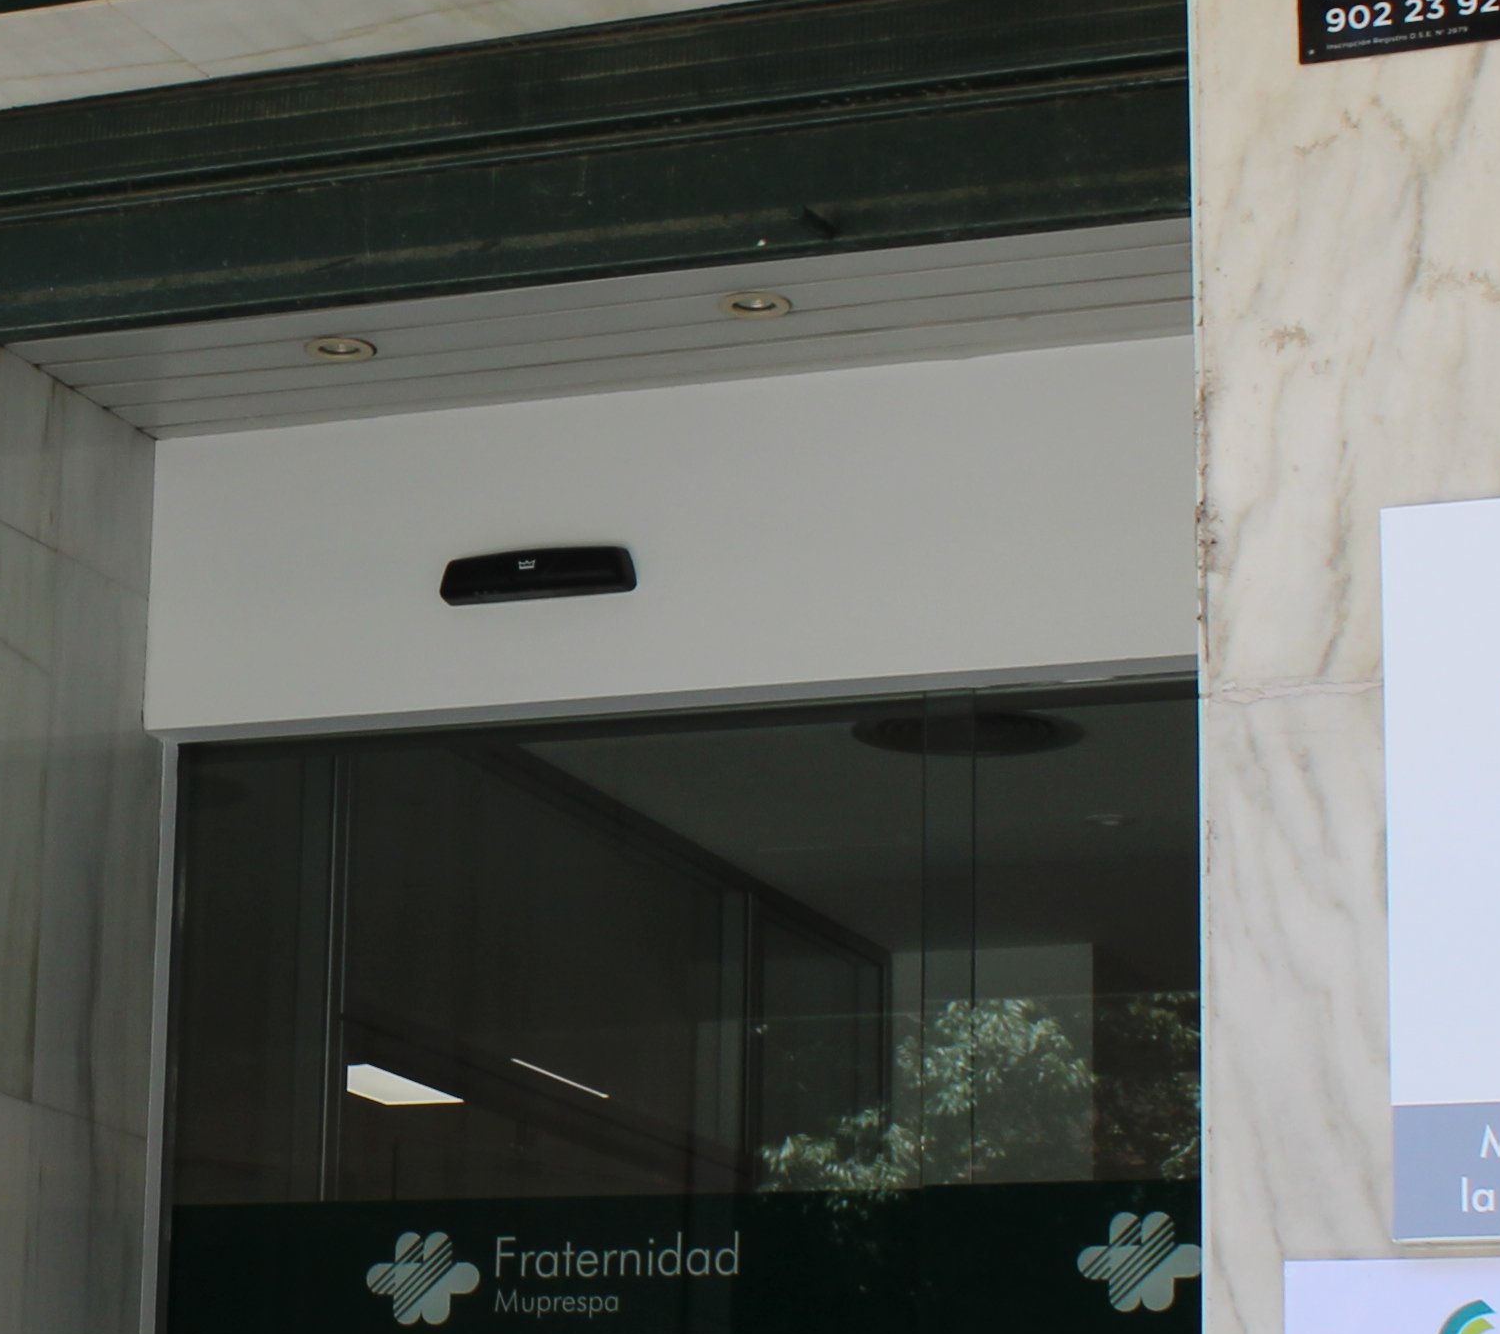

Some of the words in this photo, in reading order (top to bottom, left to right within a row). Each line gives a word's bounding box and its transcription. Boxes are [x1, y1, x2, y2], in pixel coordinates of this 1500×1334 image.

[1325, 1, 1393, 33] 902
[1460, 1176, 1496, 1213] la
[494, 1230, 739, 1278] Fraternidad
[494, 1289, 619, 1318] Muprespa
